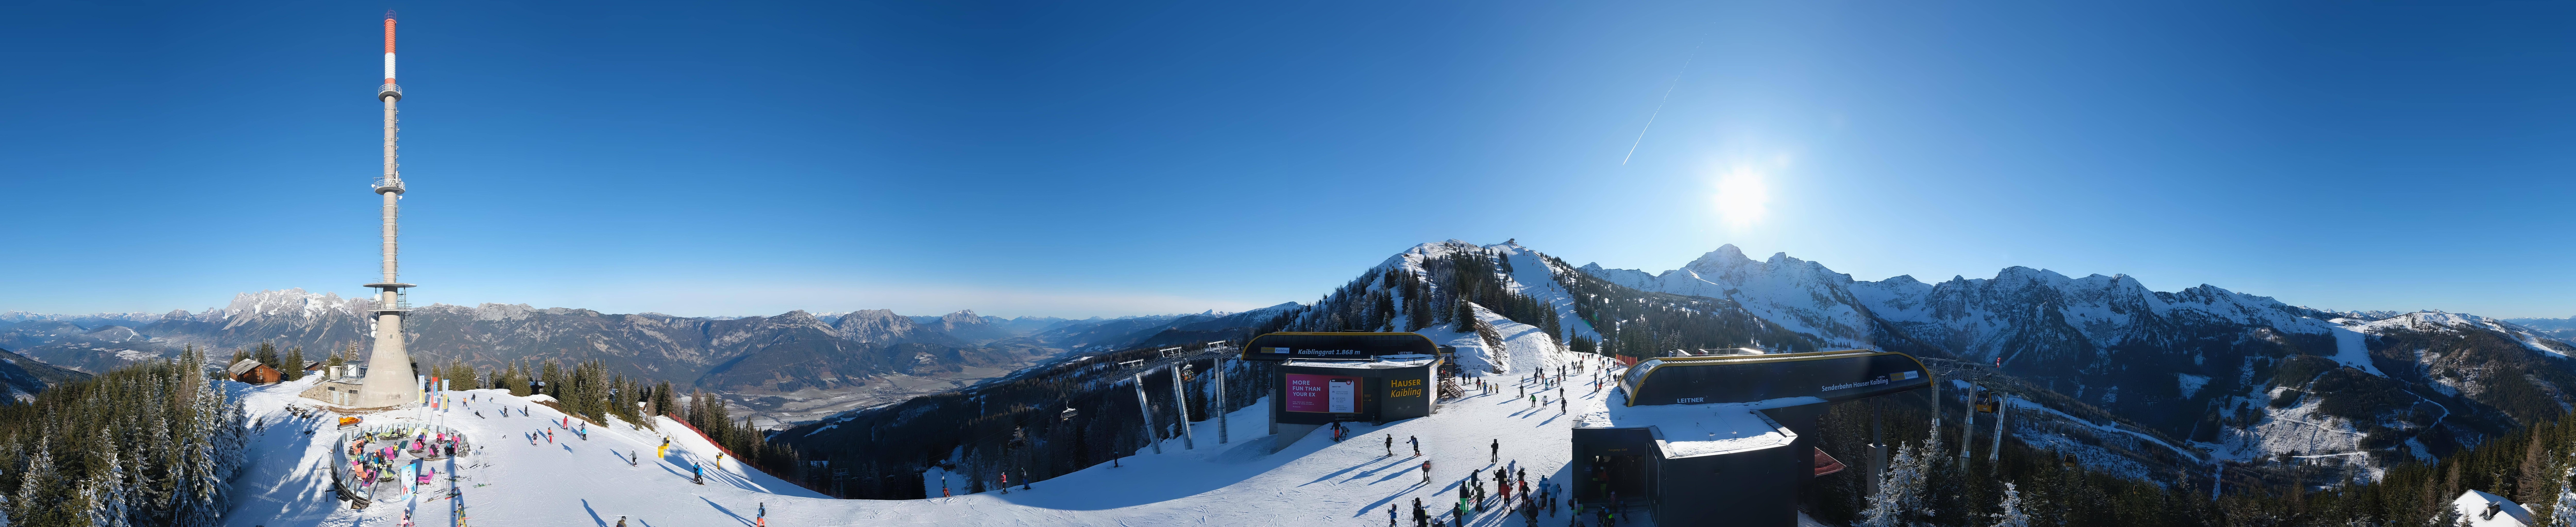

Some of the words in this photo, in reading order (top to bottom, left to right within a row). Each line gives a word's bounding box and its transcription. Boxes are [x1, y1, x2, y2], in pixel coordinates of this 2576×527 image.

[1391, 379, 1421, 387] HAUSER
[1822, 383, 1852, 392] Senderbahn
[1391, 388, 1421, 397] Kaibling
